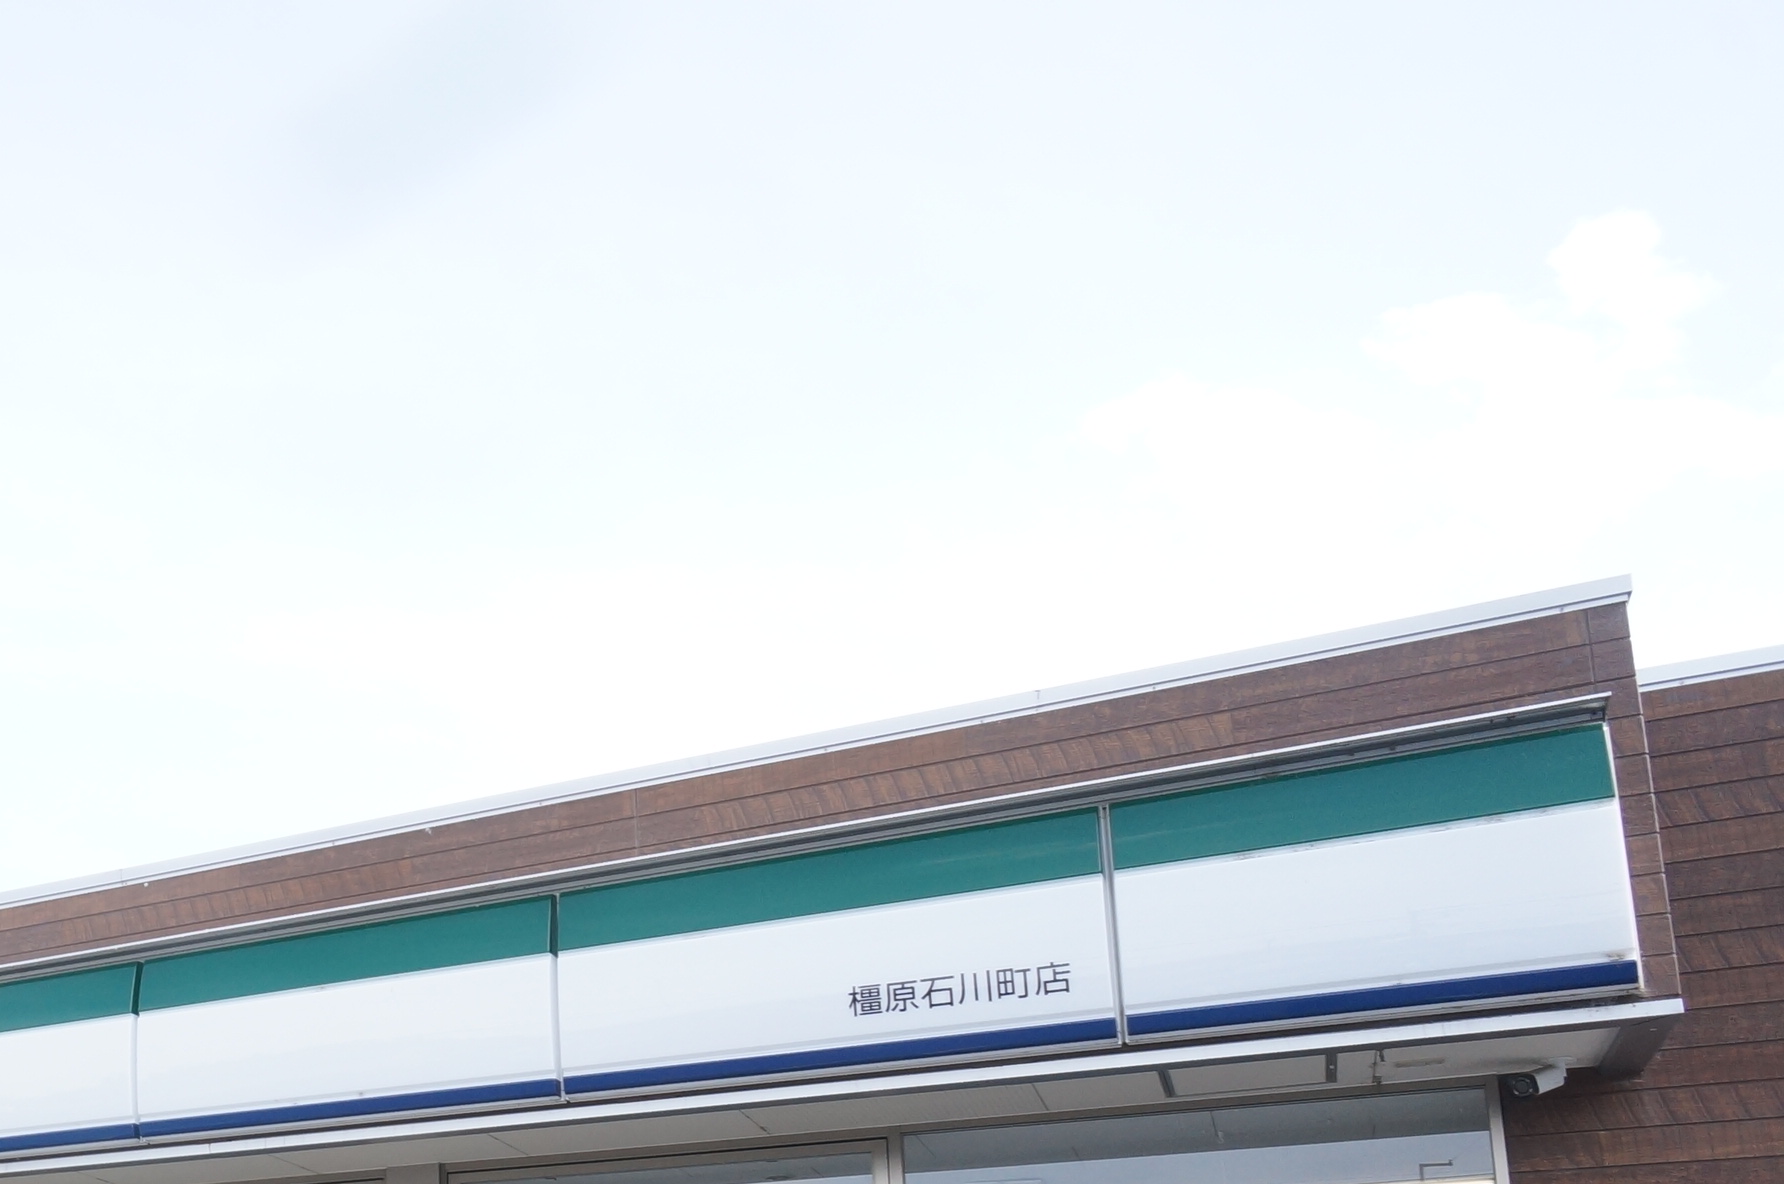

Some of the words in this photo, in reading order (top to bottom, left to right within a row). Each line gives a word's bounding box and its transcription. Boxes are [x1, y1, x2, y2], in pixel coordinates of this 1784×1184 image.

[847, 961, 1072, 1018] 橿原石川町店
